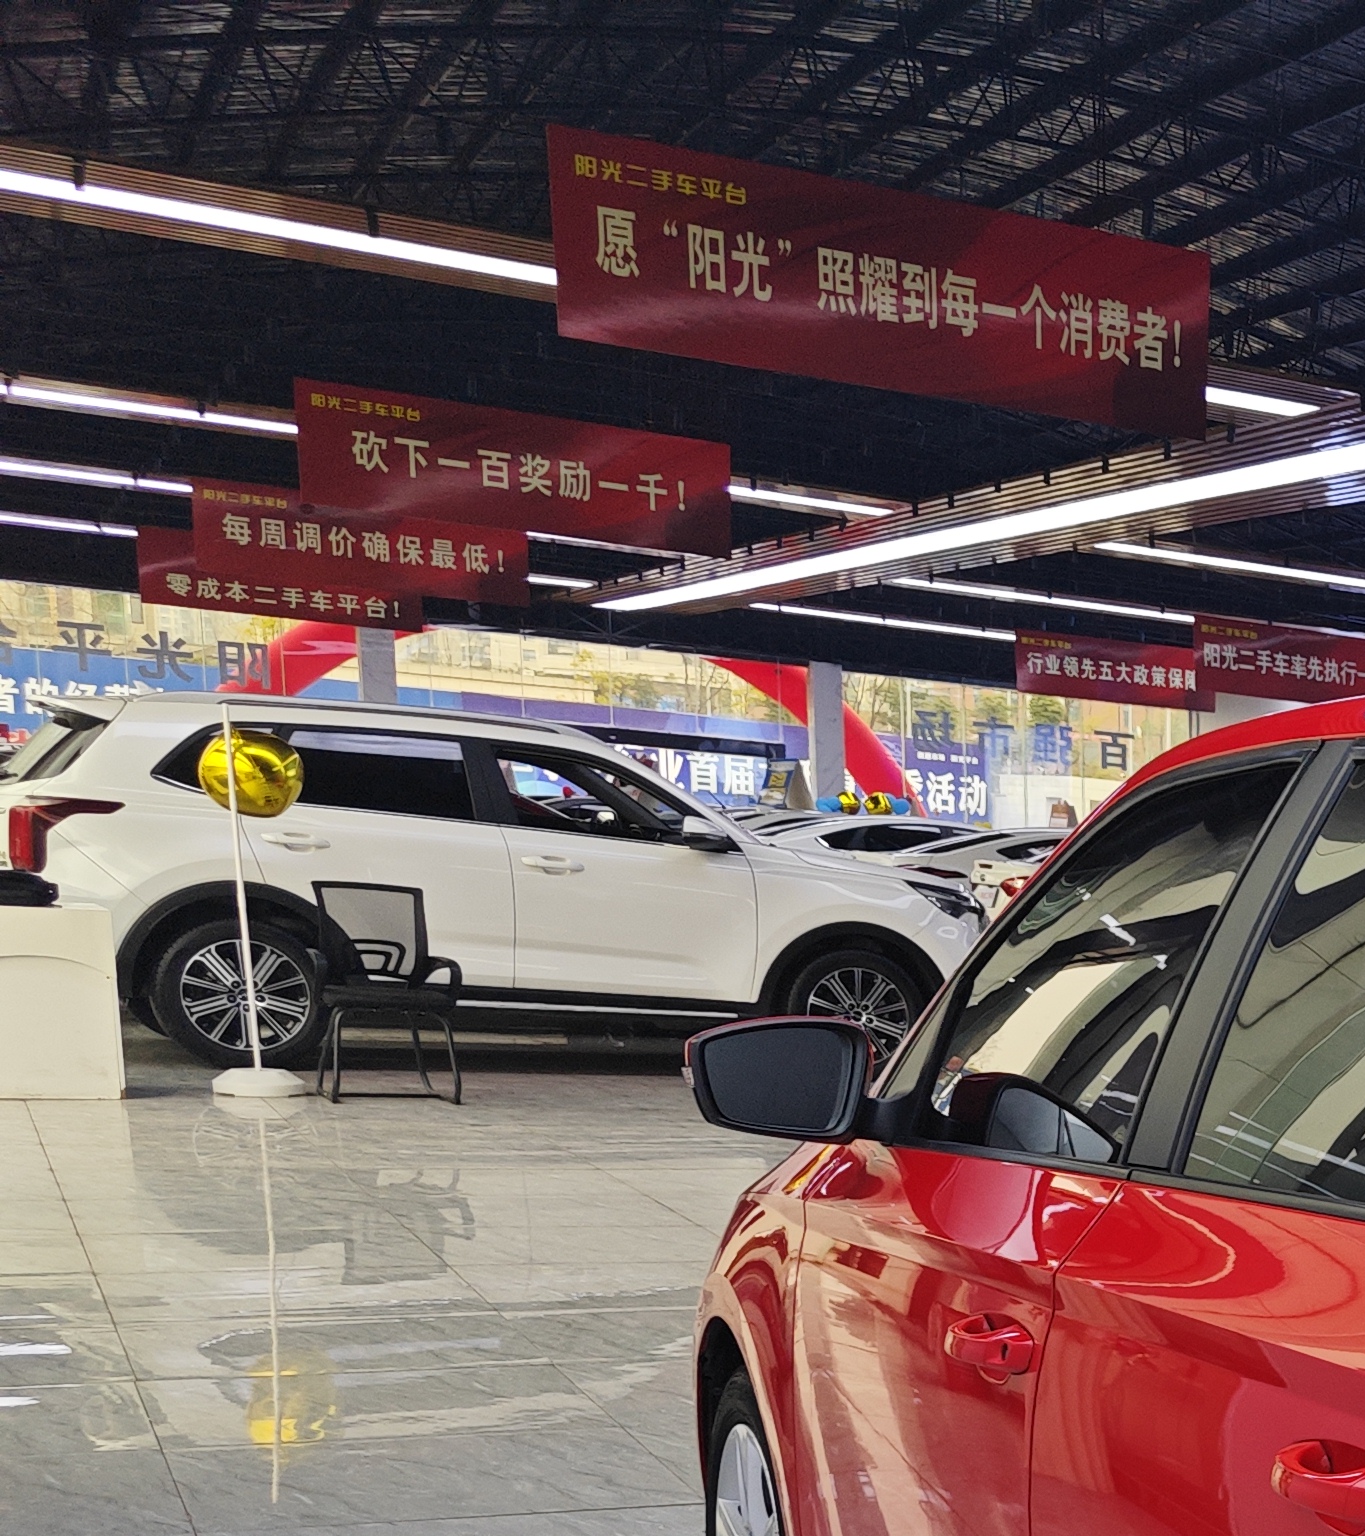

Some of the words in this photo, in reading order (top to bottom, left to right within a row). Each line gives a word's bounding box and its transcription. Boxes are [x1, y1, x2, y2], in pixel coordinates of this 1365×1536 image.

[573, 152, 748, 207] 阳光二手车平台
[310, 392, 422, 423] 阳光二手车平台
[350, 429, 688, 512] 砍下一百奖励一千!
[221, 512, 506, 576] 每周调价确保最低!
[165, 571, 402, 620] 零成本二手车平台!
